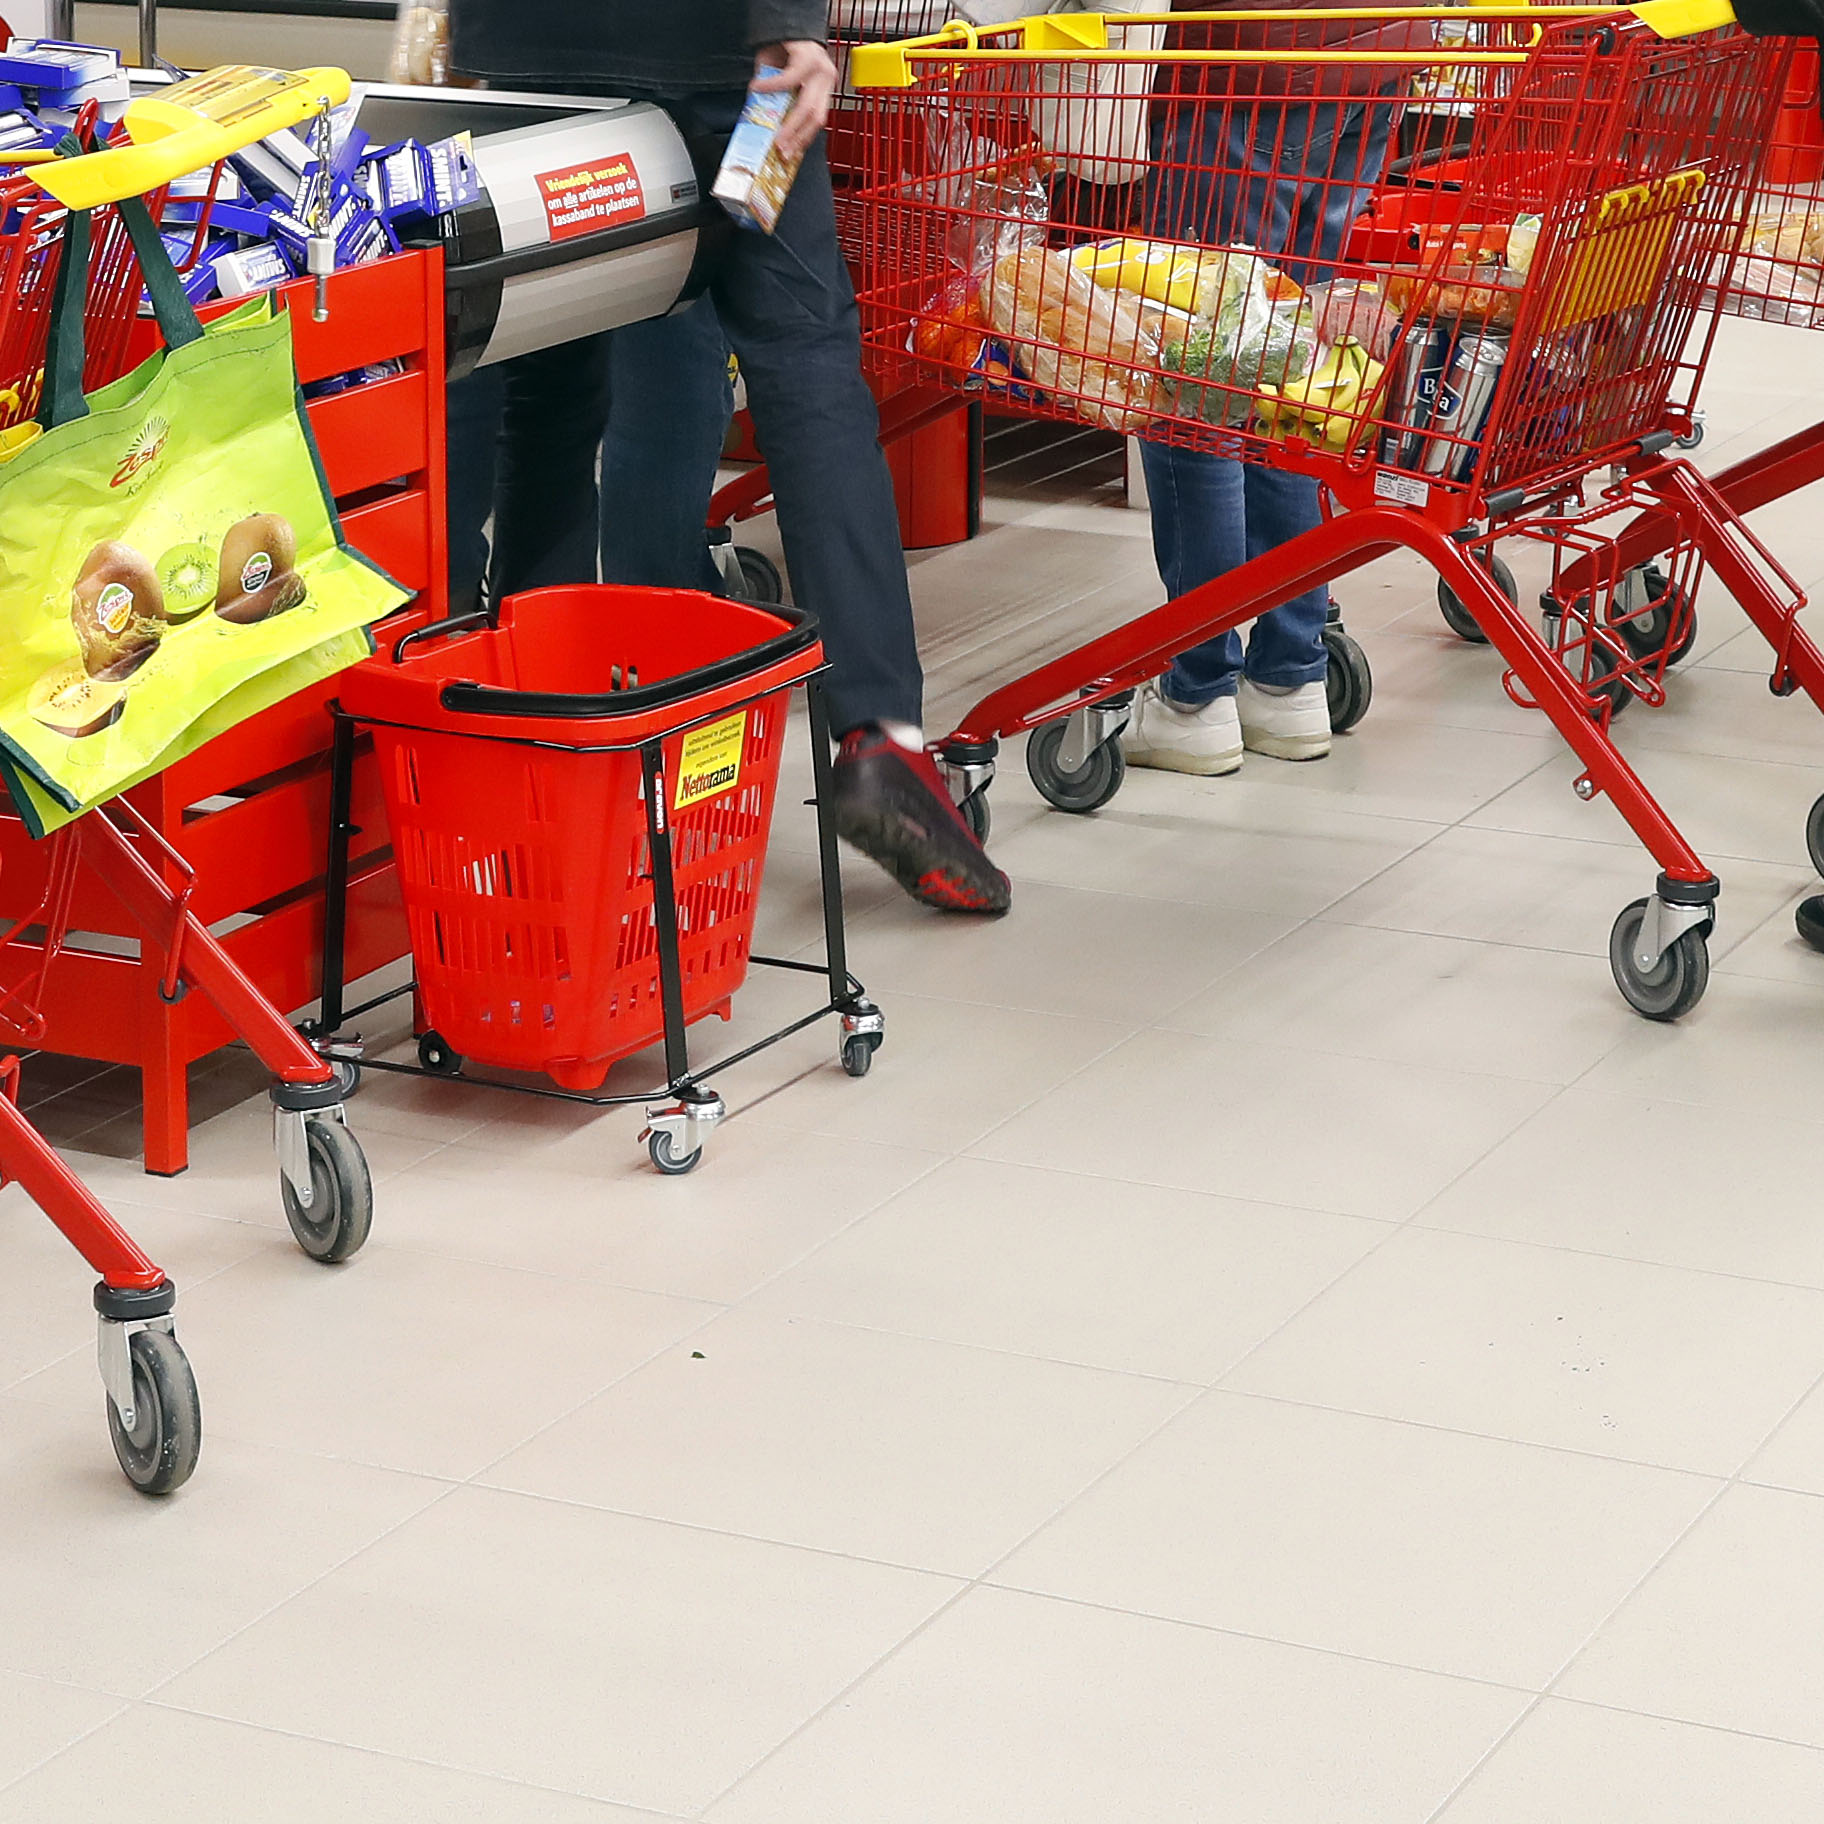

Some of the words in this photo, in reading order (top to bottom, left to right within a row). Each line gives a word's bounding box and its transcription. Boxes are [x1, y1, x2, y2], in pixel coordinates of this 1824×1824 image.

[544, 170, 595, 193] Vriendelijk
[594, 162, 629, 181] verzoek
[547, 198, 562, 211] om
[563, 192, 579, 209] alle
[578, 184, 614, 203] artikelen
[614, 182, 626, 195] op
[625, 177, 638, 190] de
[552, 205, 595, 228] kassaband
[596, 203, 605, 216] te
[605, 194, 640, 216] plaatsen
[679, 762, 737, 802] Nettorama
